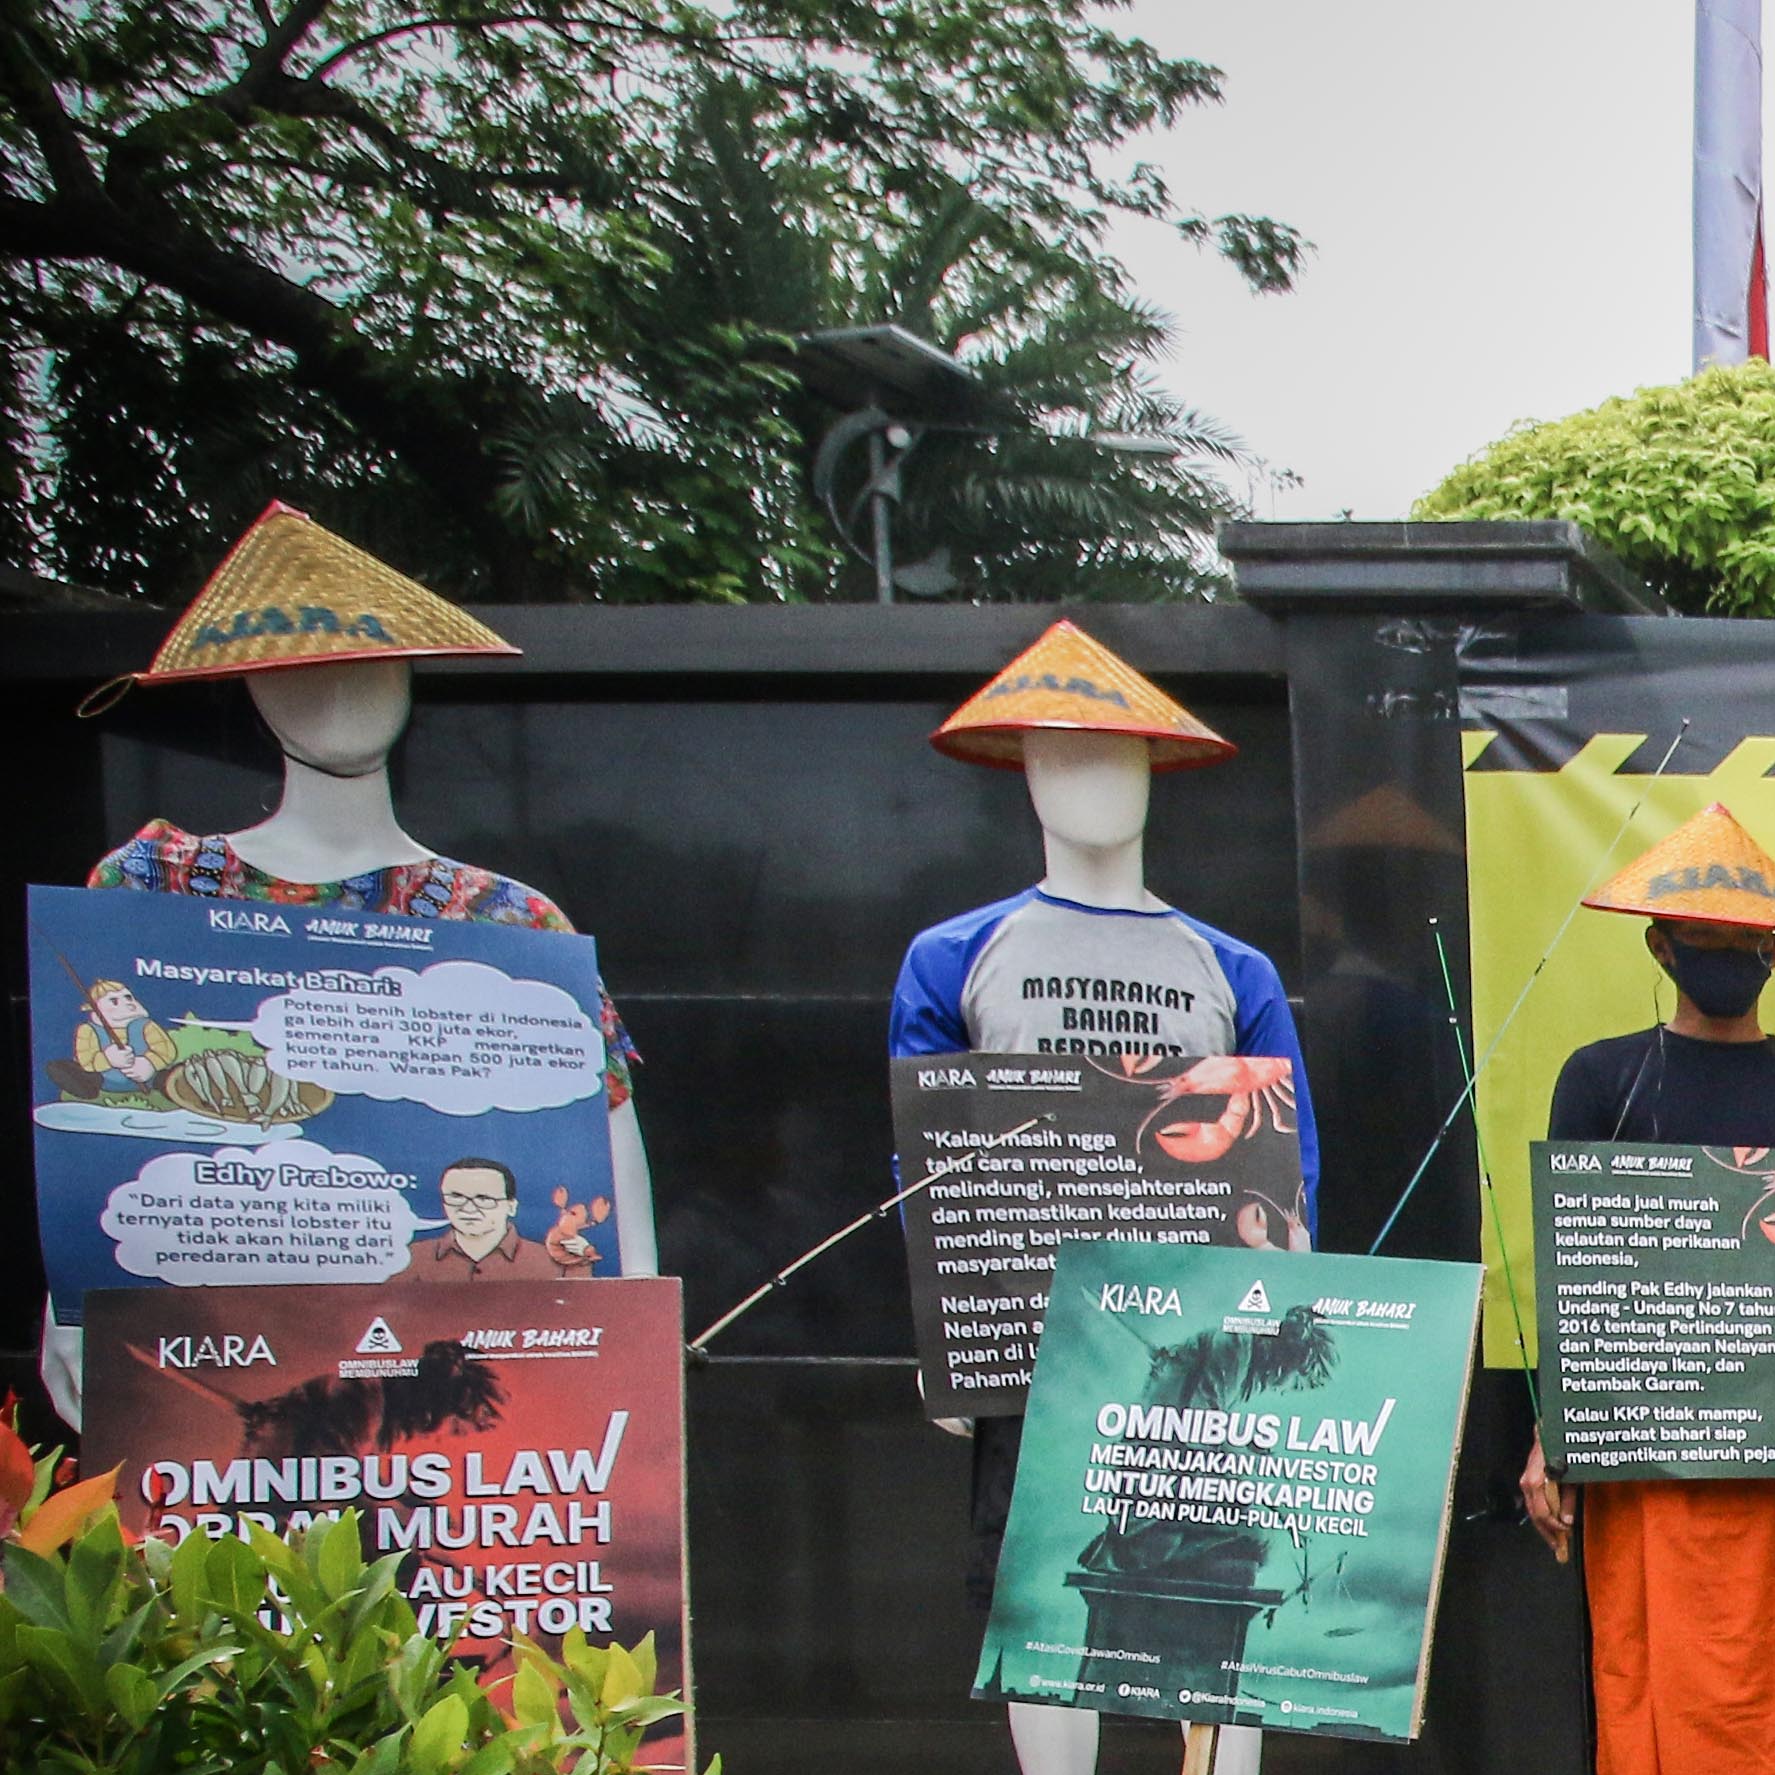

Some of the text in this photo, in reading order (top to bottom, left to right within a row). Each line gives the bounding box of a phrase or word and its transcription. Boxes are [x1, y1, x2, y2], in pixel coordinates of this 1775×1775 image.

[210, 910, 290, 935] KIARA
[135, 958, 402, 997] Masyarakat Bahari:
[1022, 978, 1194, 1012] MASYARAKAT
[284, 999, 582, 1029] Potensi benih lobster di Indonesia
[1063, 1007, 1159, 1034] BAHARI
[918, 1069, 976, 1087] KIARA
[1000, 1131, 1062, 1148] masih
[1068, 1133, 1116, 1153] ngga
[195, 1162, 417, 1190] Edhy Prabowo:
[1550, 1154, 1601, 1171] KIARA
[929, 1179, 1231, 1201] melindungi, mensejahterakan
[1554, 1194, 1719, 1212] Dari pada jual murah
[188, 1196, 236, 1210] data
[241, 1198, 288, 1215] yang
[293, 1198, 331, 1211] kita
[337, 1199, 391, 1213] miliki
[932, 1203, 1227, 1224] dan memastikan kedaulatan,
[1556, 1252, 1639, 1268] Indonesia,
[1100, 1284, 1182, 1317] KIARA
[1558, 1302, 1620, 1318] Undang
[1634, 1302, 1695, 1320] Undang
[1699, 1303, 1721, 1316] No
[1724, 1304, 1734, 1316] 7
[1558, 1320, 1600, 1334] 2016
[159, 1335, 275, 1369] KIARA
[1096, 1398, 1396, 1456] OMNIBUS LAW
[141, 1411, 629, 1507] OMNIBUS LAW
[1091, 1444, 1377, 1486] MEMANJAKAN INVESTOR
[1085, 1469, 1374, 1514] UNTUK MENGKAPLING
[378, 1502, 612, 1550] MURAH
[1082, 1497, 1368, 1548] LAUT DAN PULAU-PULAU KECIL
[486, 1562, 613, 1596] KECIL
